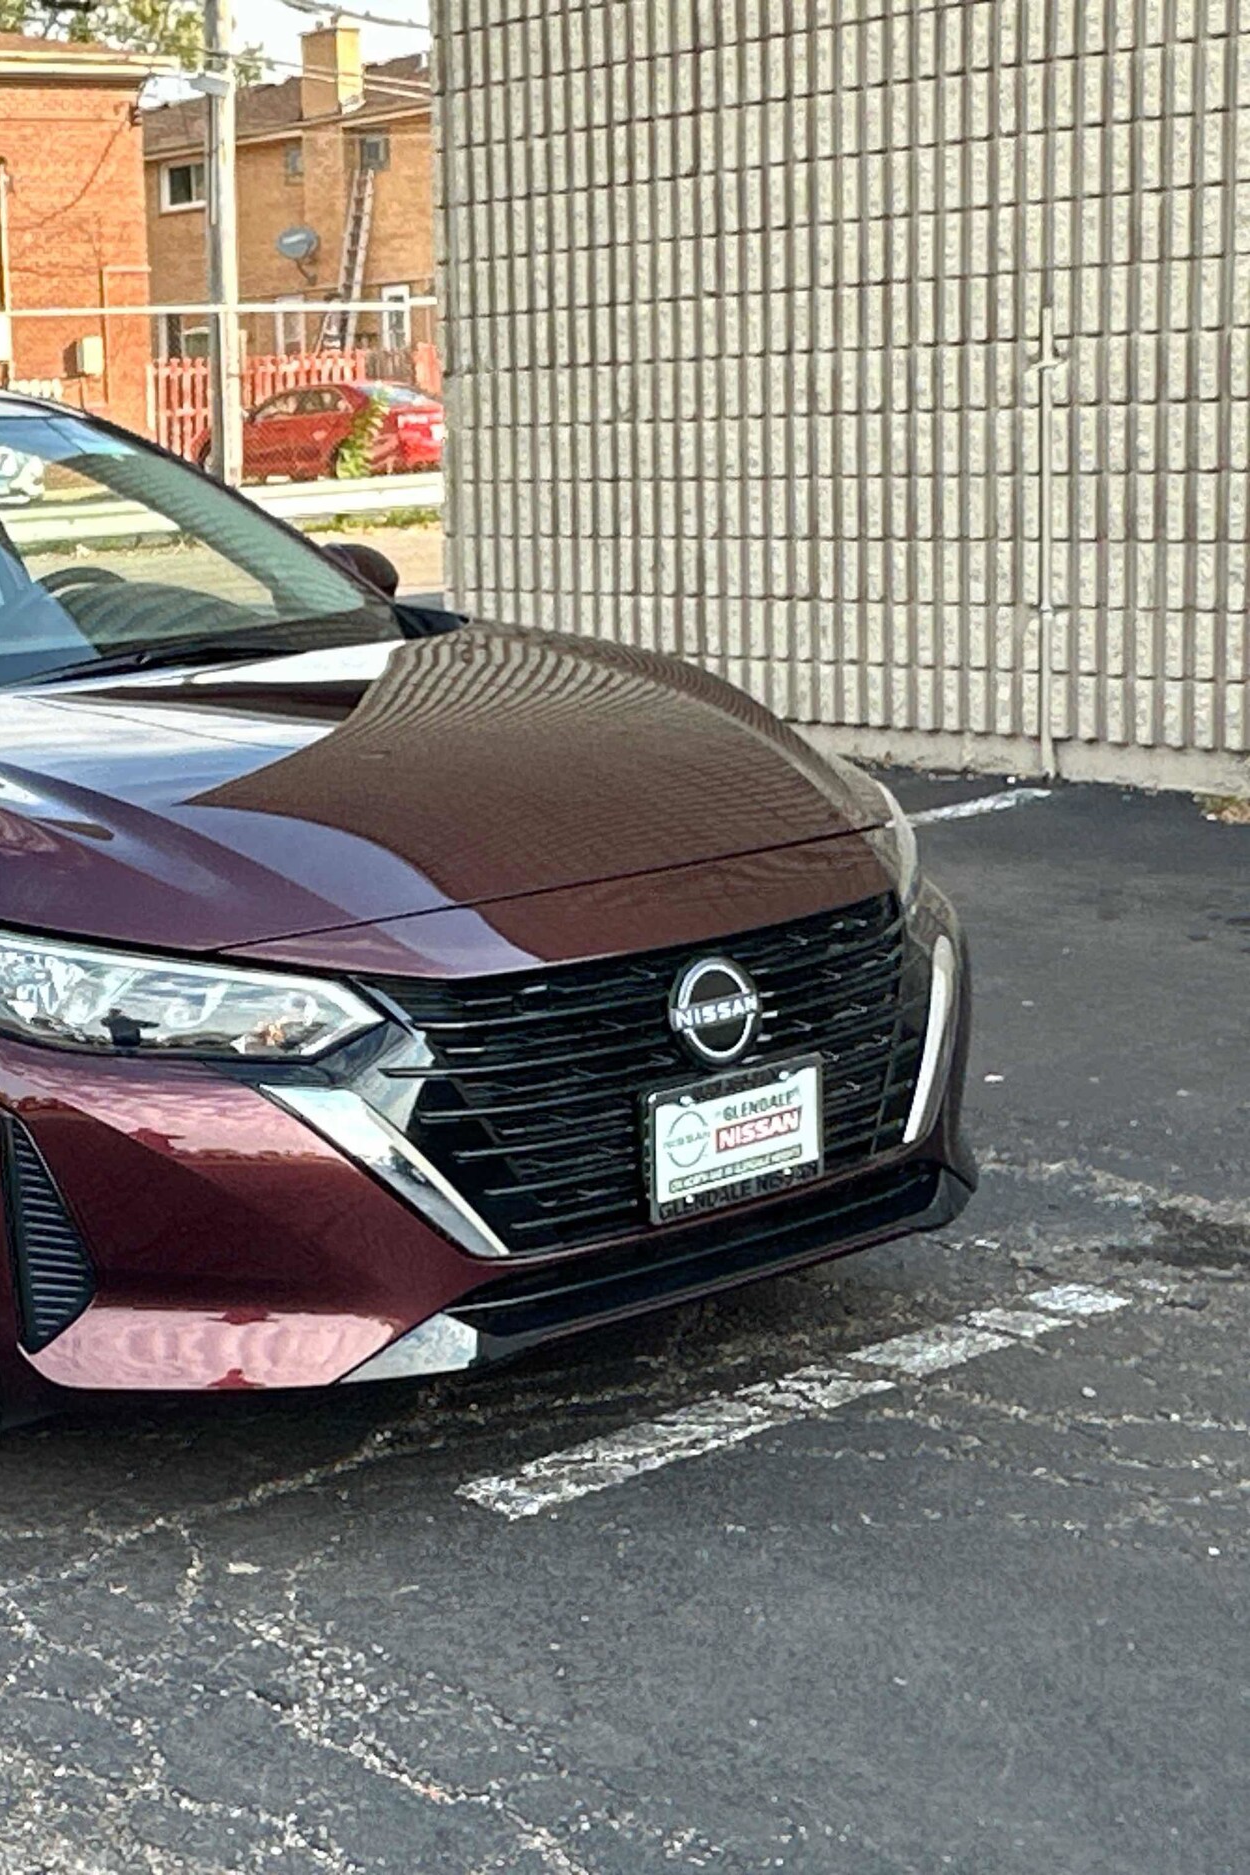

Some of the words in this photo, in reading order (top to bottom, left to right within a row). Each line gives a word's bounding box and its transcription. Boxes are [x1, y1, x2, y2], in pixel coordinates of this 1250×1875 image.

[675, 994, 758, 1030] NISSAN
[722, 1091, 793, 1122] GLENDALE
[718, 1109, 800, 1151] NISSAN
[659, 1180, 752, 1220] GLENDALE
